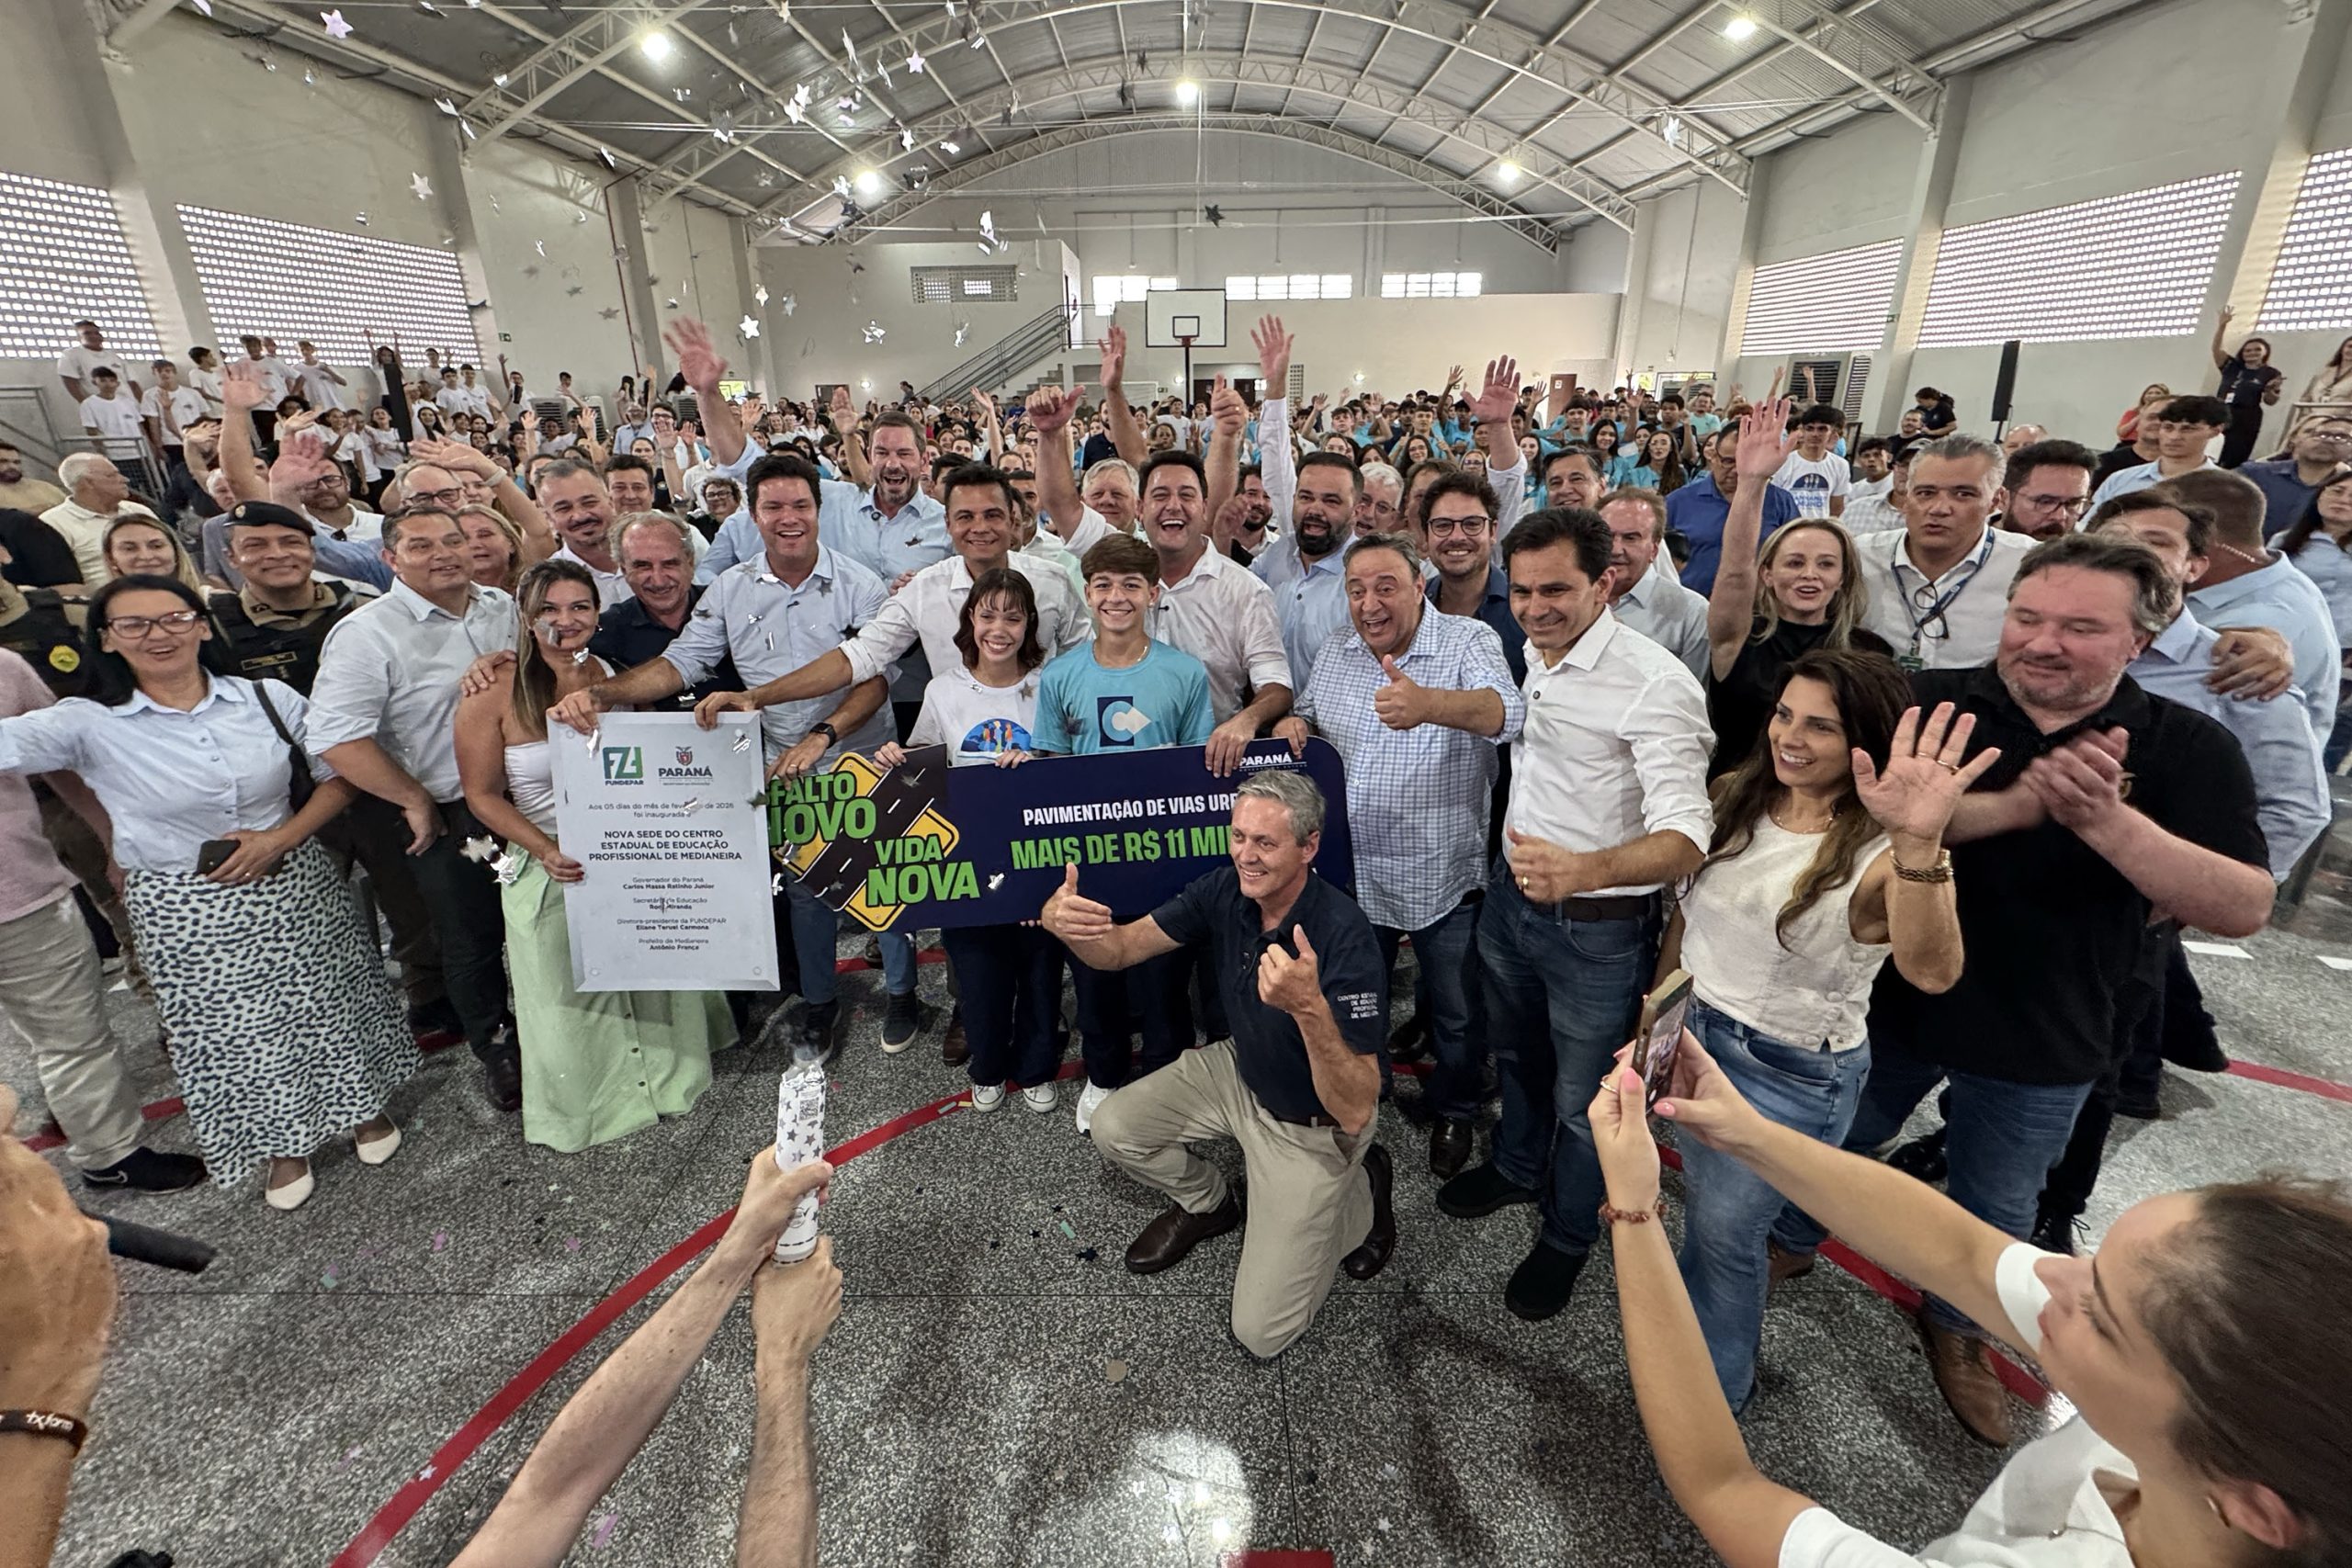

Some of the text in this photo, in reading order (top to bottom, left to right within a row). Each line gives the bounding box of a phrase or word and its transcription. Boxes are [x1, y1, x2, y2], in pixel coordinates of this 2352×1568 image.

[1239, 751, 1293, 766] PARANÁ
[658, 766, 713, 777] PARANÁ
[1023, 799, 1143, 826] PAVIMENTAÇÃO
[1147, 798, 1167, 817] DE
[1168, 795, 1205, 815] VIAS
[604, 830, 635, 839] NOVA
[601, 841, 654, 850] ESTADUAL
[673, 840, 729, 851] EDUCAÇÃO
[875, 836, 943, 865] VIDA
[1011, 836, 1081, 870] MAIS
[1085, 833, 1121, 864] DE
[1124, 829, 1161, 863] R$
[1164, 829, 1187, 859] 11
[589, 852, 662, 861] PROFISSIONAL
[867, 862, 980, 907] NOVA
